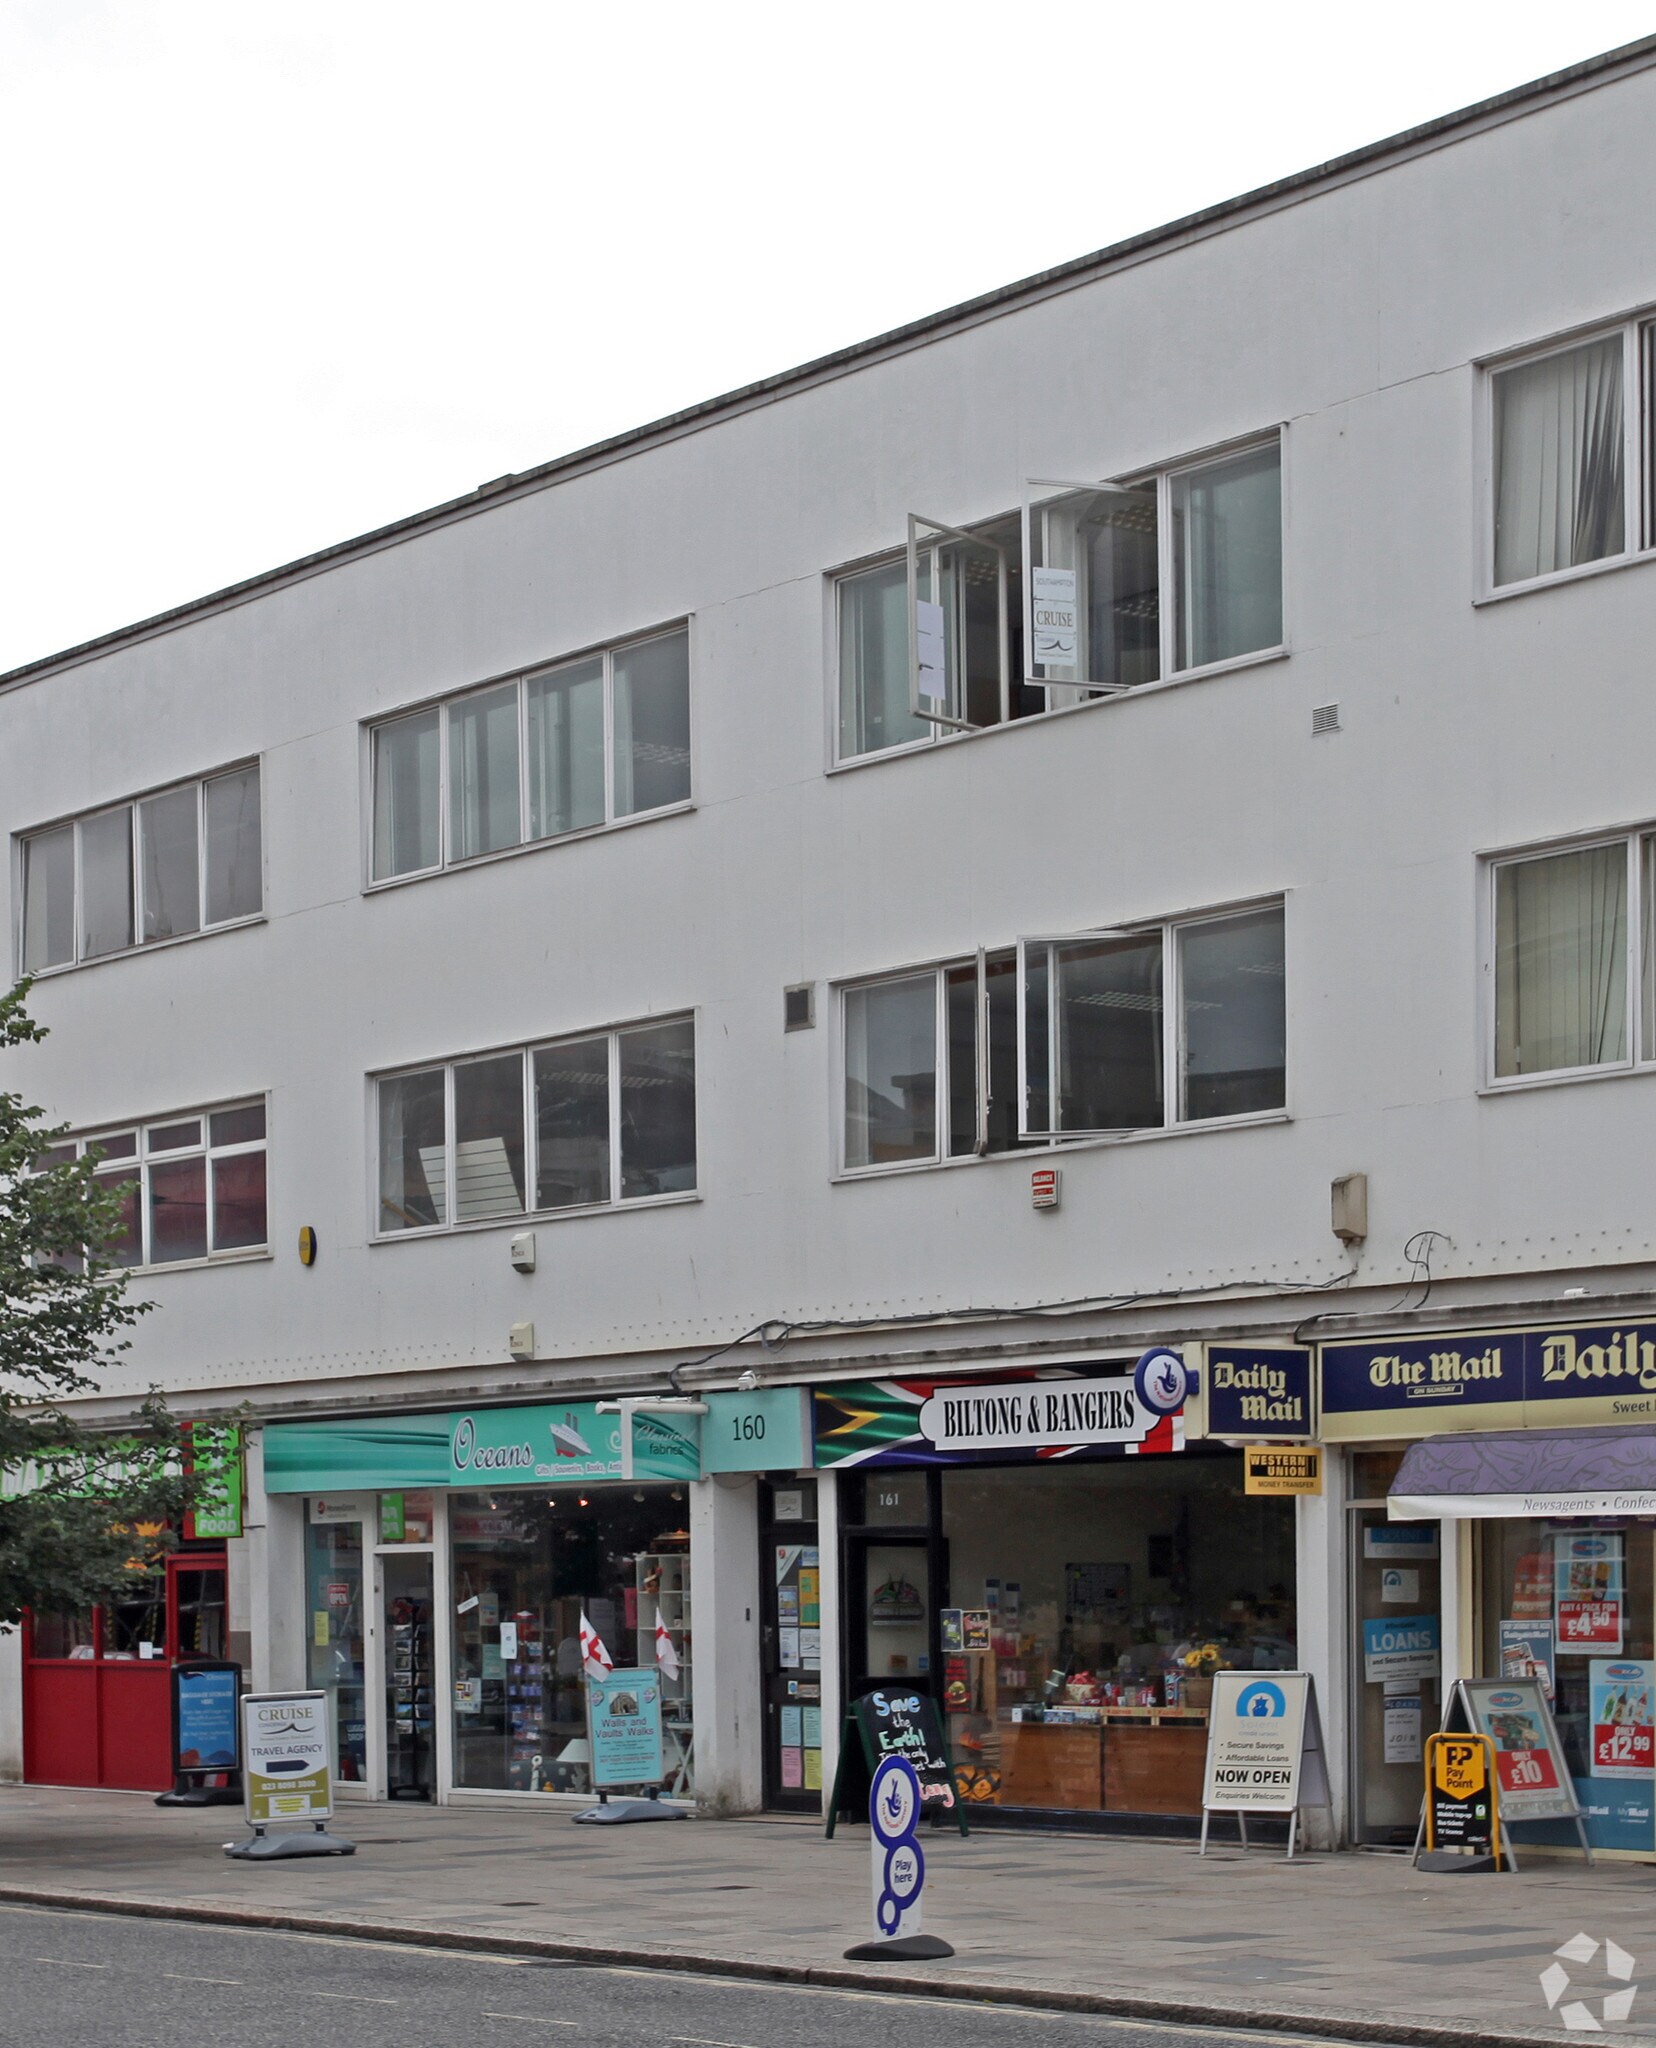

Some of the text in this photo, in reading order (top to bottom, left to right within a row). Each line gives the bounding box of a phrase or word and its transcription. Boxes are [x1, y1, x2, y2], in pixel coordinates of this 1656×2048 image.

[1036, 609, 1073, 627] CRUISE
[1369, 1348, 1503, 1387] The Mail
[1213, 1362, 1287, 1398] Daily
[1427, 1385, 1456, 1394] SUNDAY
[944, 1389, 1135, 1437] BILTONG & BANGERS
[1240, 1394, 1303, 1421] Mail
[1612, 1401, 1650, 1414] Sweet
[732, 1414, 765, 1441] 160
[453, 1416, 534, 1470] Oceans
[1250, 1455, 1306, 1466] WESTERN
[1267, 1466, 1306, 1477] UNION
[1257, 1480, 1314, 1488] MONEY TRANSFER
[879, 1494, 899, 1506] 161
[1523, 1498, 1595, 1512] Newsagents
[200, 1520, 238, 1533] FOOD
[1560, 1602, 1617, 1612] ANY 4 PACK FOR
[1567, 1612, 1610, 1636] £4.50
[1371, 1630, 1432, 1652] LOANS
[1385, 1656, 1407, 1664] Secure
[1409, 1654, 1434, 1663] Savings
[872, 1692, 920, 1716] Save
[258, 1707, 313, 1721] CRUISE
[893, 1713, 911, 1728] the
[602, 1717, 647, 1727] Walls and
[595, 1726, 654, 1738] Vaults Walks
[1615, 1726, 1636, 1736] ONLY
[878, 1726, 926, 1750] Earth!
[1389, 1734, 1417, 1743] JOIN
[251, 1744, 323, 1756] TRAVEL AGENCY
[1227, 1741, 1284, 1751] Secure Savings
[1599, 1736, 1650, 1760] £12.99
[1225, 1754, 1265, 1762] Affordable
[1511, 1751, 1531, 1760] ONLY
[1215, 1770, 1291, 1784] NOW OPEN
[1446, 1767, 1464, 1779] Pay
[1511, 1760, 1542, 1784] £10
[1446, 1778, 1473, 1788] Point
[1215, 1791, 1285, 1800] Enquiries Welcome
[895, 1859, 912, 1875] Play
[894, 1872, 913, 1884] here
